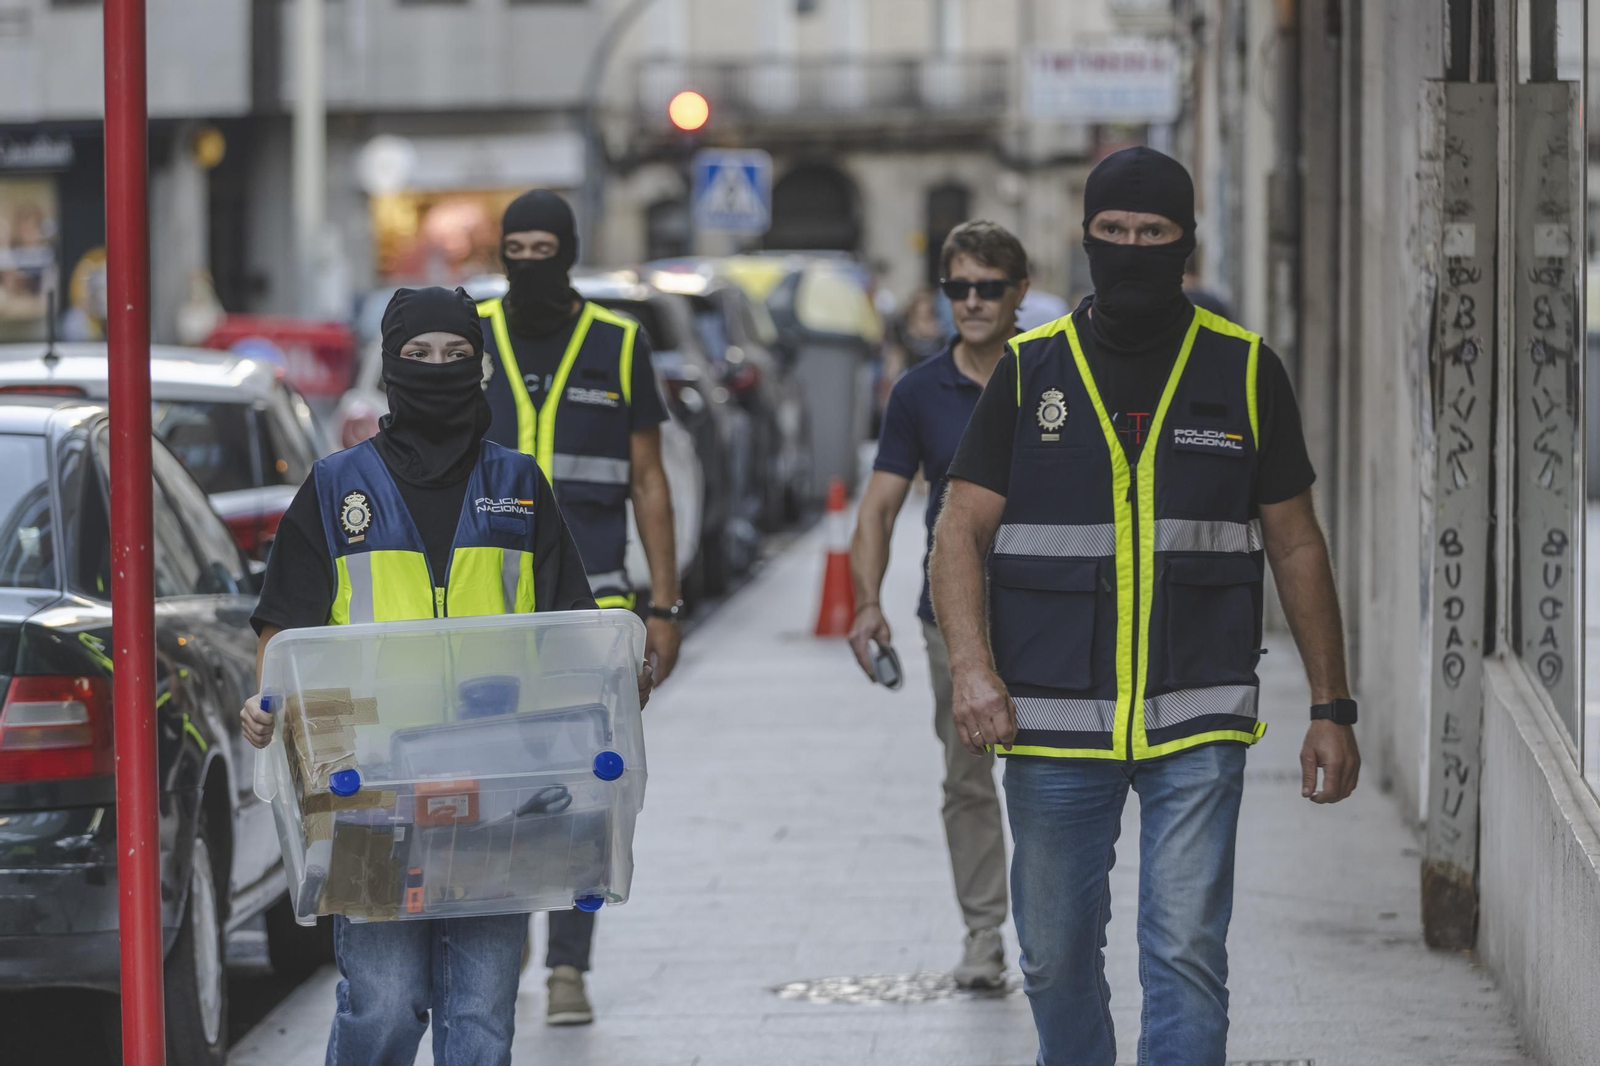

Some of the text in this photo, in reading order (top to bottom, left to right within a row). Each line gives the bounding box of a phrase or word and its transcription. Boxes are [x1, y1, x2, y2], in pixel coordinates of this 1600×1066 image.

[1173, 428, 1226, 440] POLICIA
[1174, 436, 1243, 450] NACIONAL
[475, 497, 520, 506] POLICIA
[476, 504, 535, 515] NACIONAL
